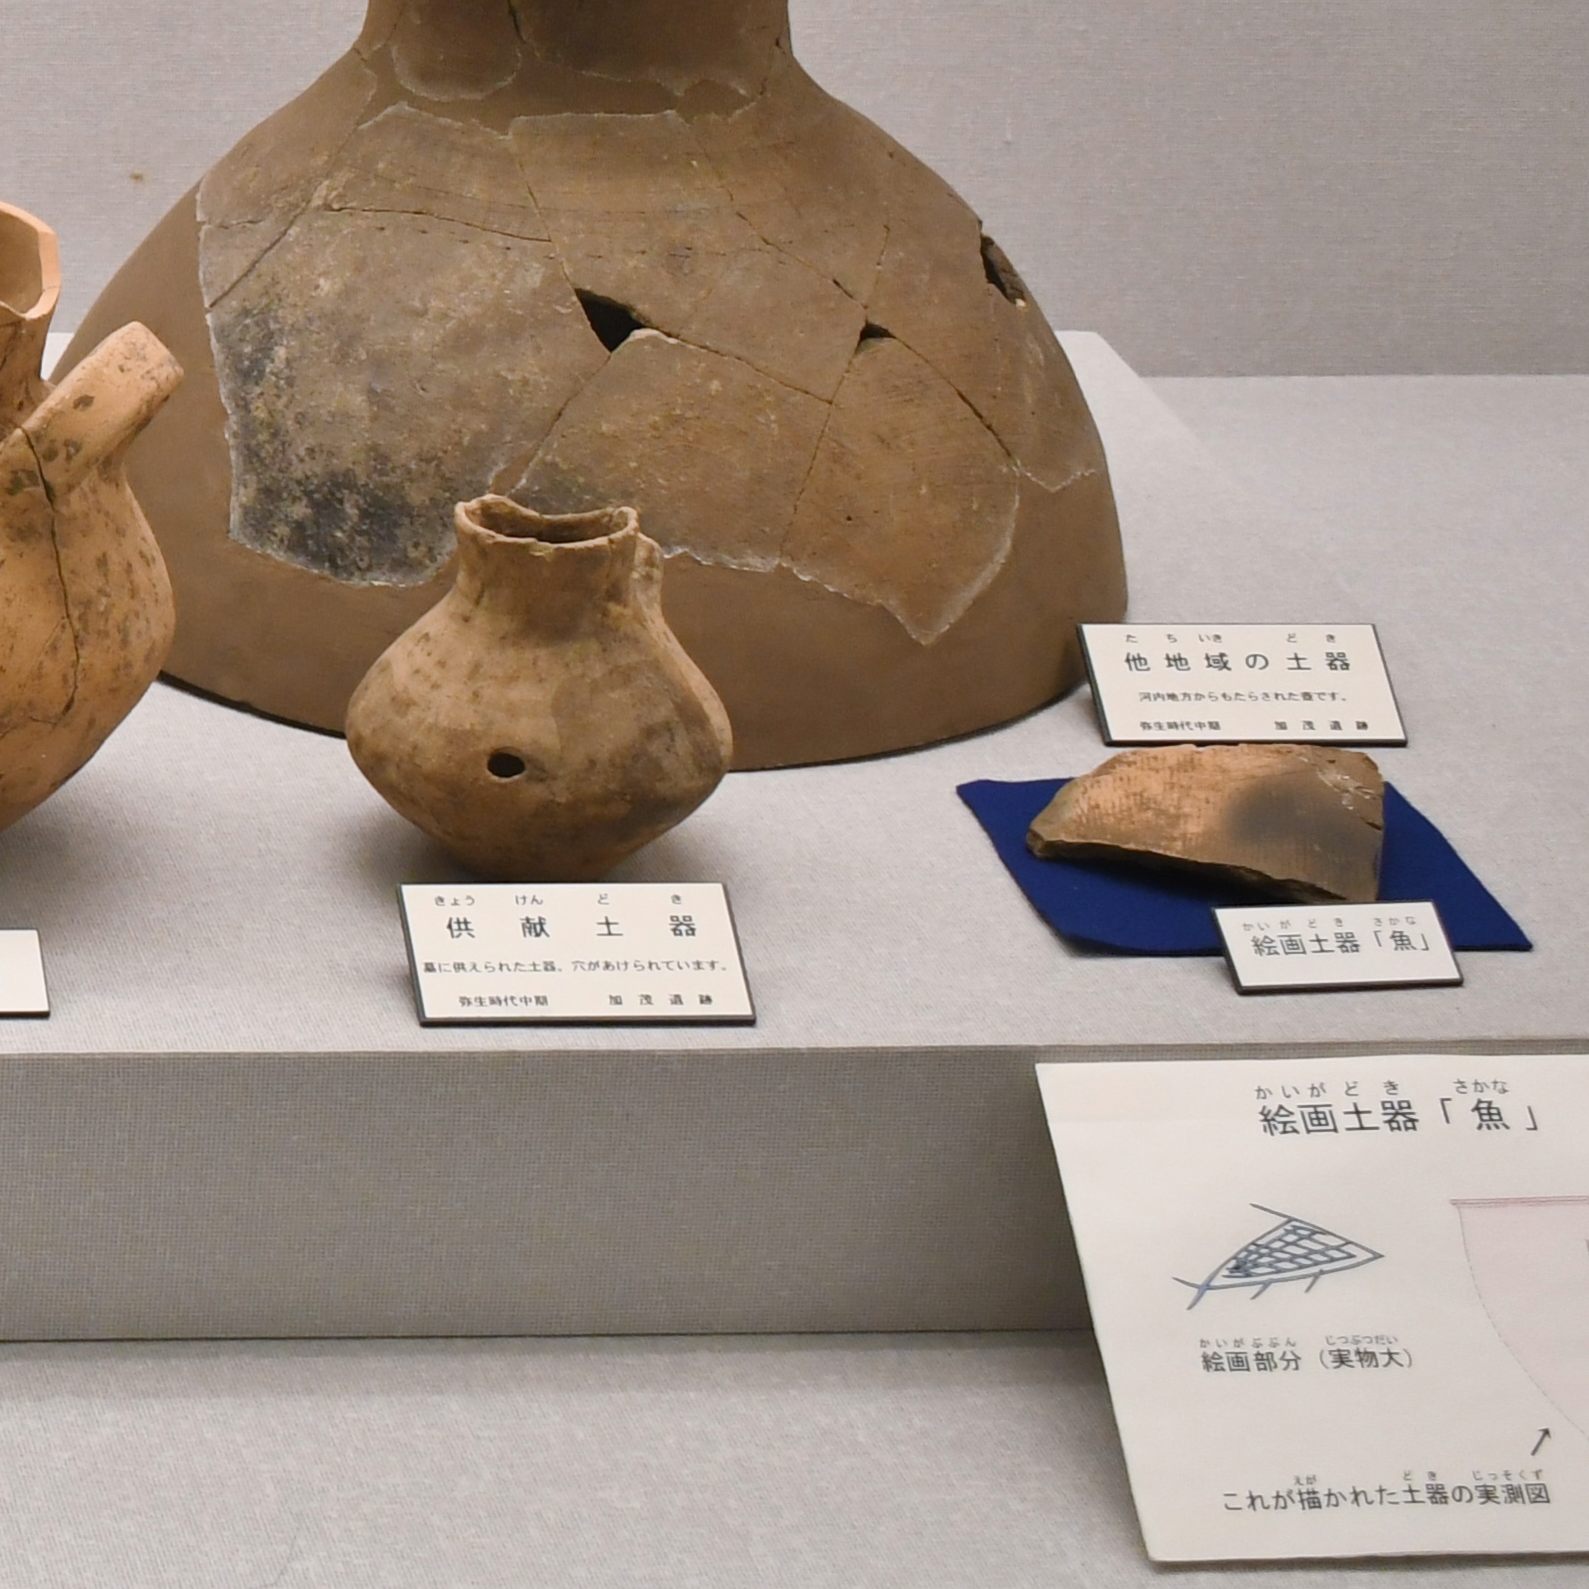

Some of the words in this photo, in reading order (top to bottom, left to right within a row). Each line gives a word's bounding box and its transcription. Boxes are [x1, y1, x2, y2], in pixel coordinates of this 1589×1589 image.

[1124, 651, 1351, 672] 他地域の土器
[1222, 1482, 1551, 1512] これが描かれた土器の実測図
